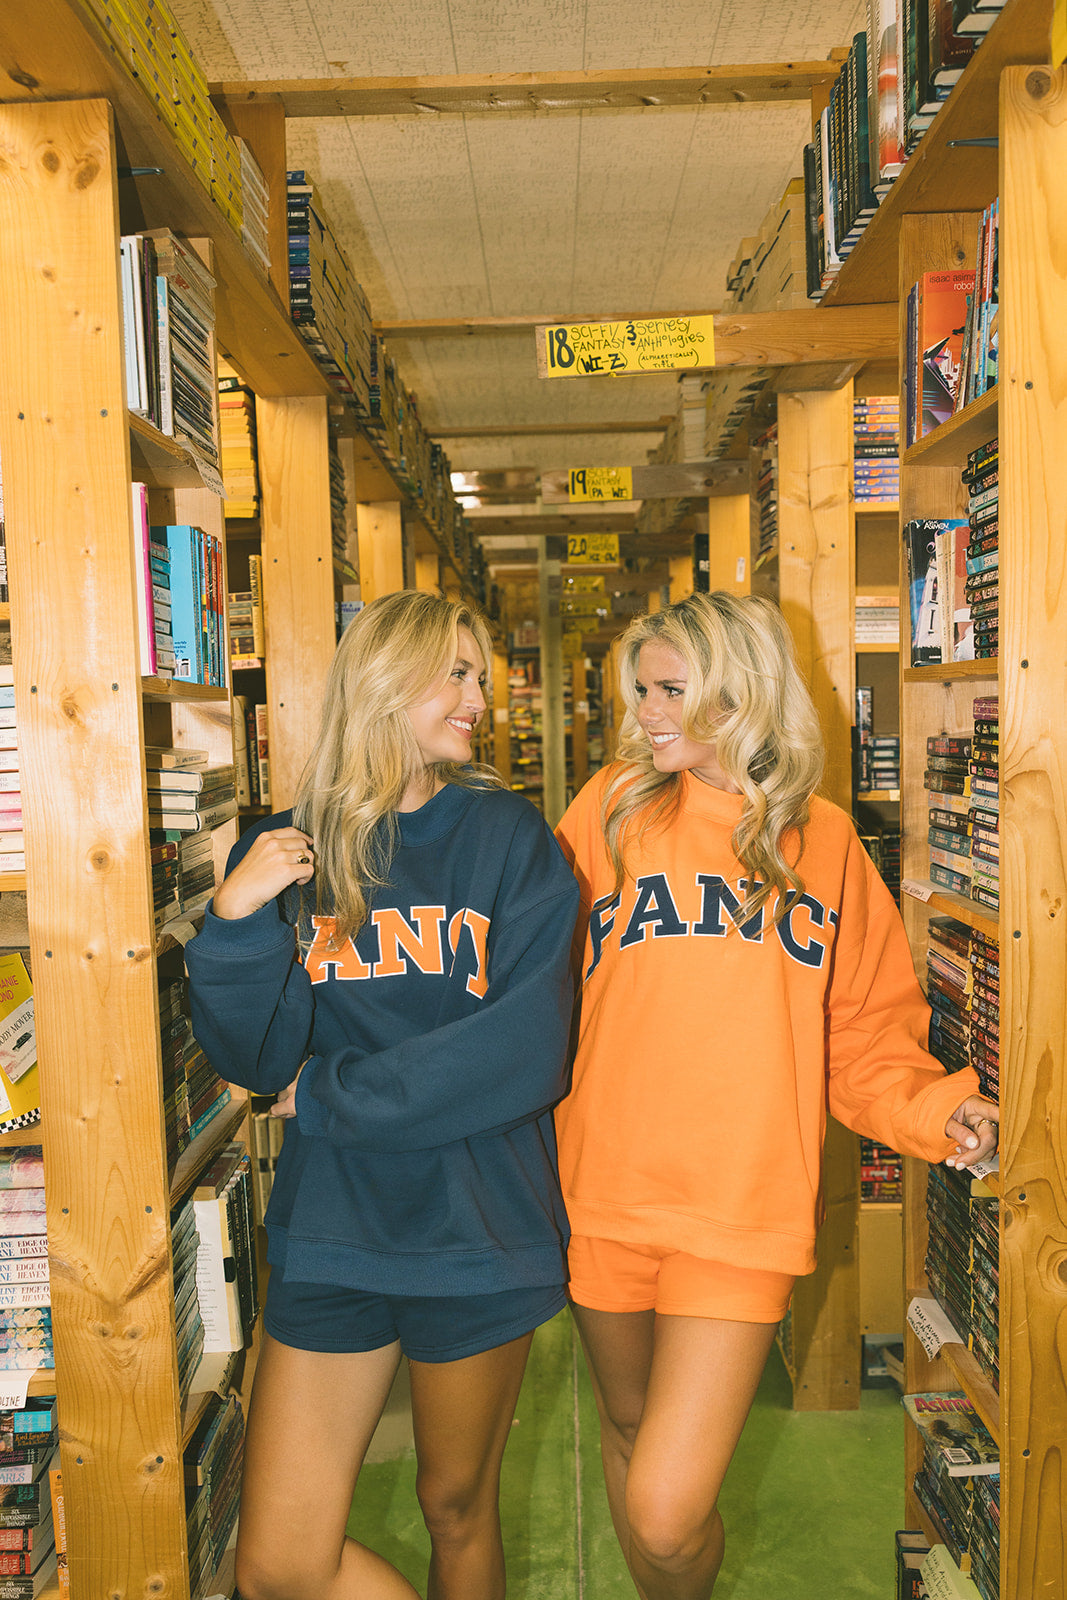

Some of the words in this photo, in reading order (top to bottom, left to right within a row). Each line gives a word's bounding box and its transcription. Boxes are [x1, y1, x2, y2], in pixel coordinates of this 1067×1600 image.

[930, 275, 950, 283] isaac
[954, 281, 974, 290] robot
[548, 328, 575, 368] 18
[573, 335, 626, 353] FANTASY
[571, 470, 587, 495] 19
[568, 538, 587, 556] 20
[583, 872, 838, 984] FANC
